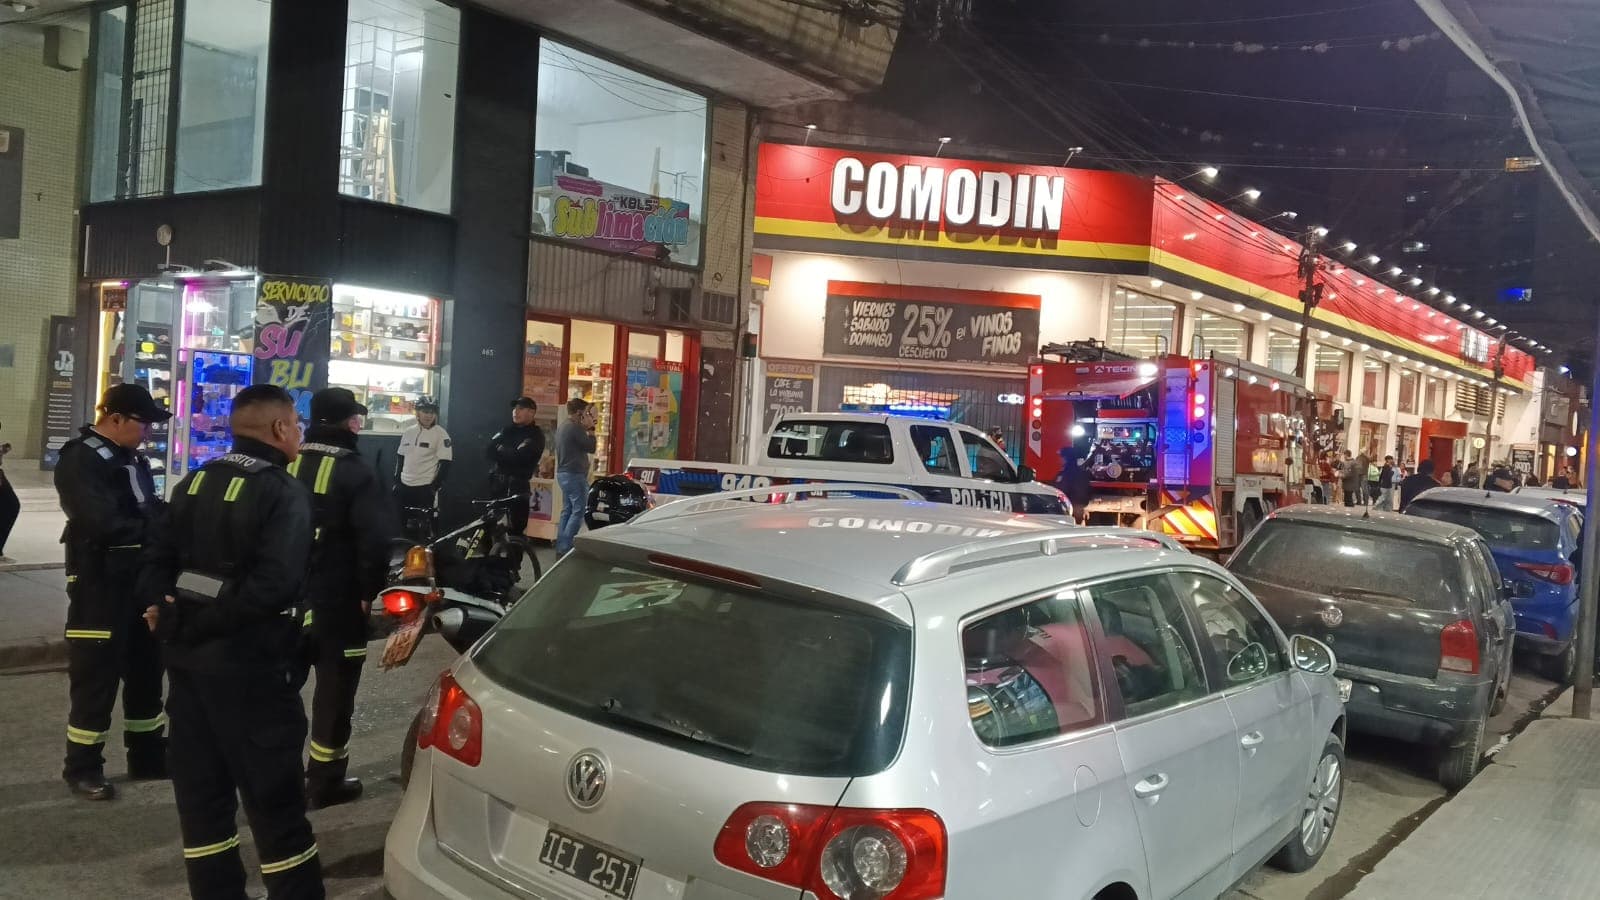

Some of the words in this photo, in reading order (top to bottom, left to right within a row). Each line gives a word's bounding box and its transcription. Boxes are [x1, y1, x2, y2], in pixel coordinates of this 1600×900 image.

[832, 157, 1064, 231] COMODIN
[853, 300, 896, 318] VIERNES
[850, 317, 890, 332] SABADO
[901, 304, 953, 347] 25%
[970, 311, 1013, 339] VINOS
[254, 324, 303, 359] SU
[849, 332, 893, 348] DOMINGO
[898, 345, 948, 359] DESCUENTO
[981, 331, 1022, 357] FINOS
[767, 363, 813, 374] OFERTAS
[951, 487, 1013, 512] POLICIA
[588, 852, 629, 896] 251
